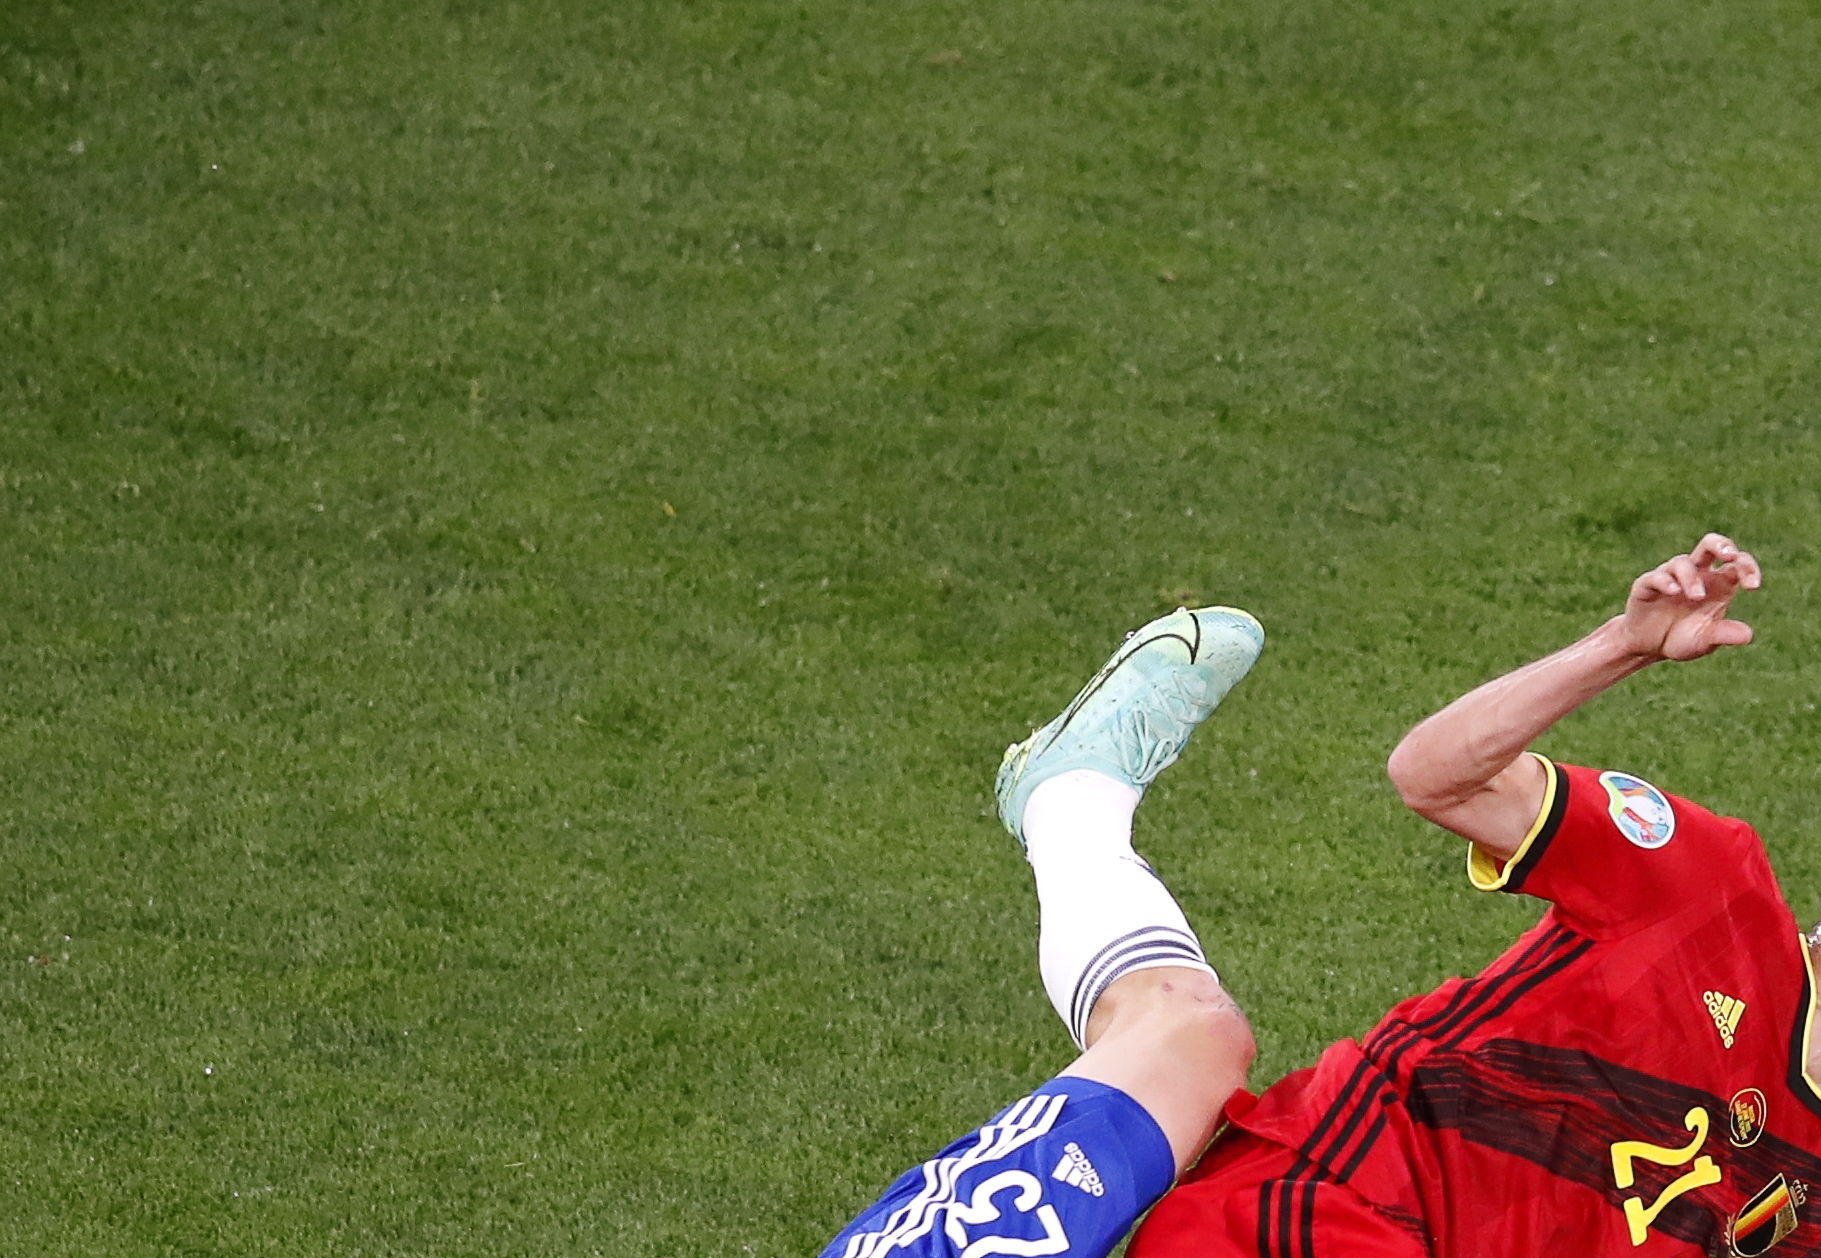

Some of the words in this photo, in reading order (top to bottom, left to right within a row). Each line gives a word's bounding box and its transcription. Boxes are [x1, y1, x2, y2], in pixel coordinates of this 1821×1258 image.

[1703, 990, 1734, 1049] adidas
[1064, 1142, 1104, 1197] adidas
[1610, 1107, 1722, 1247] 21
